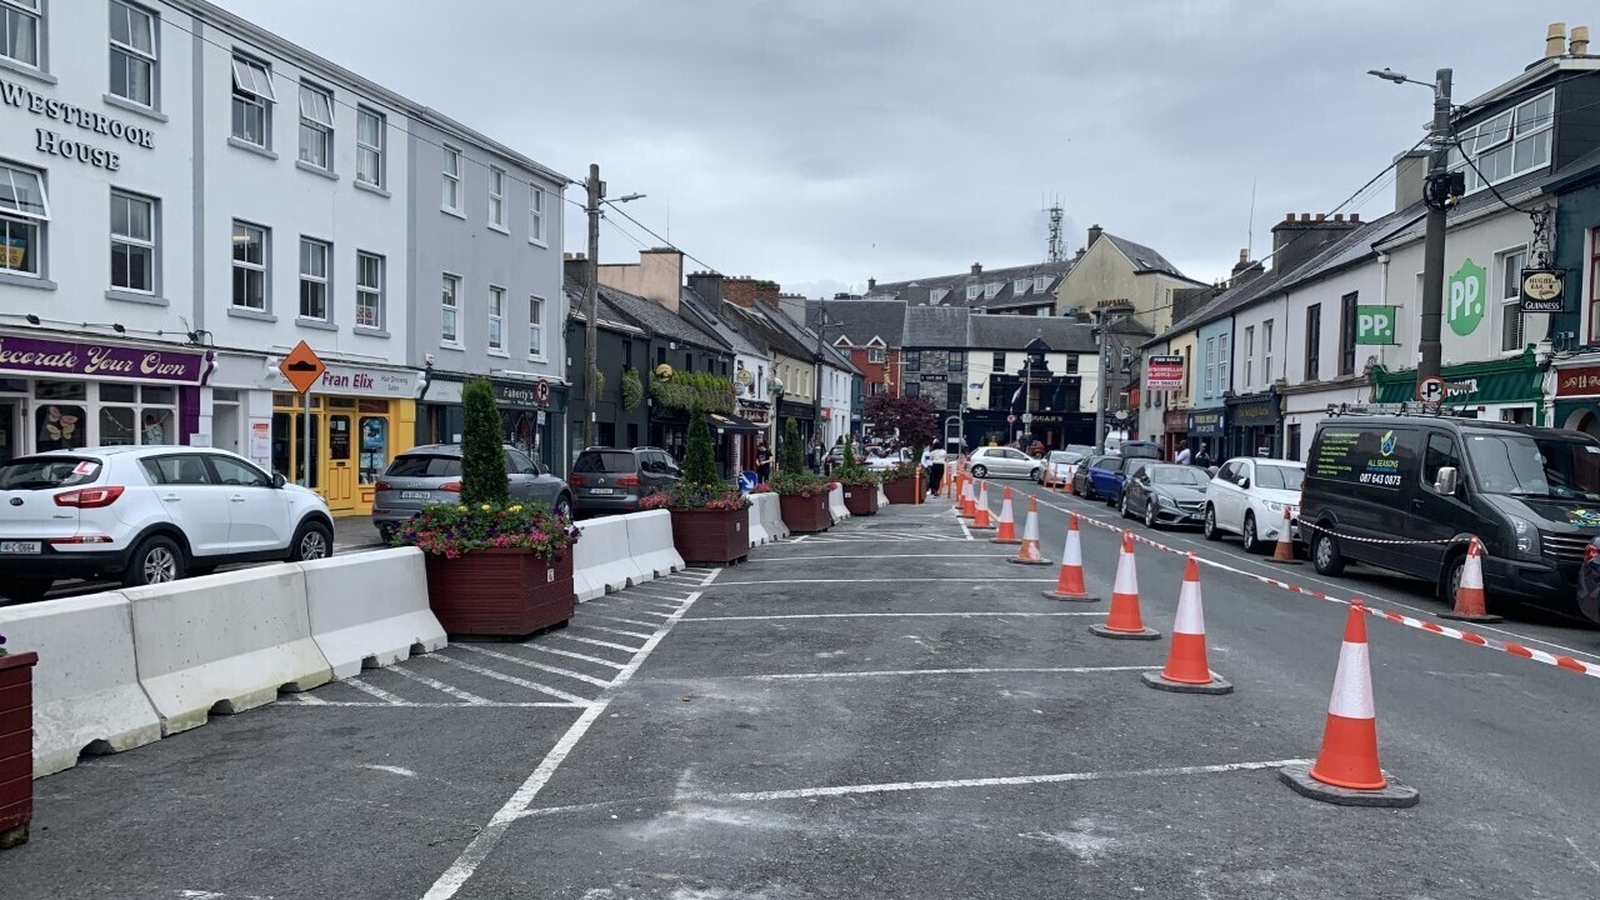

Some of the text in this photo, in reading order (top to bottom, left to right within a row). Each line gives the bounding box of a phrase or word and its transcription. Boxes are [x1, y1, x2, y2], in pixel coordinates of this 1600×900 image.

[0, 79, 156, 149] WESTBROOK
[36, 128, 121, 171] HOUSE
[1525, 301, 1560, 310] GUINNESS
[84, 347, 134, 374] Your
[140, 352, 186, 376] Own
[322, 371, 374, 390] Fran Elix
[1367, 459, 1399, 468] ALL SEASONS
[1359, 473, 1401, 486] 087 643 0873
